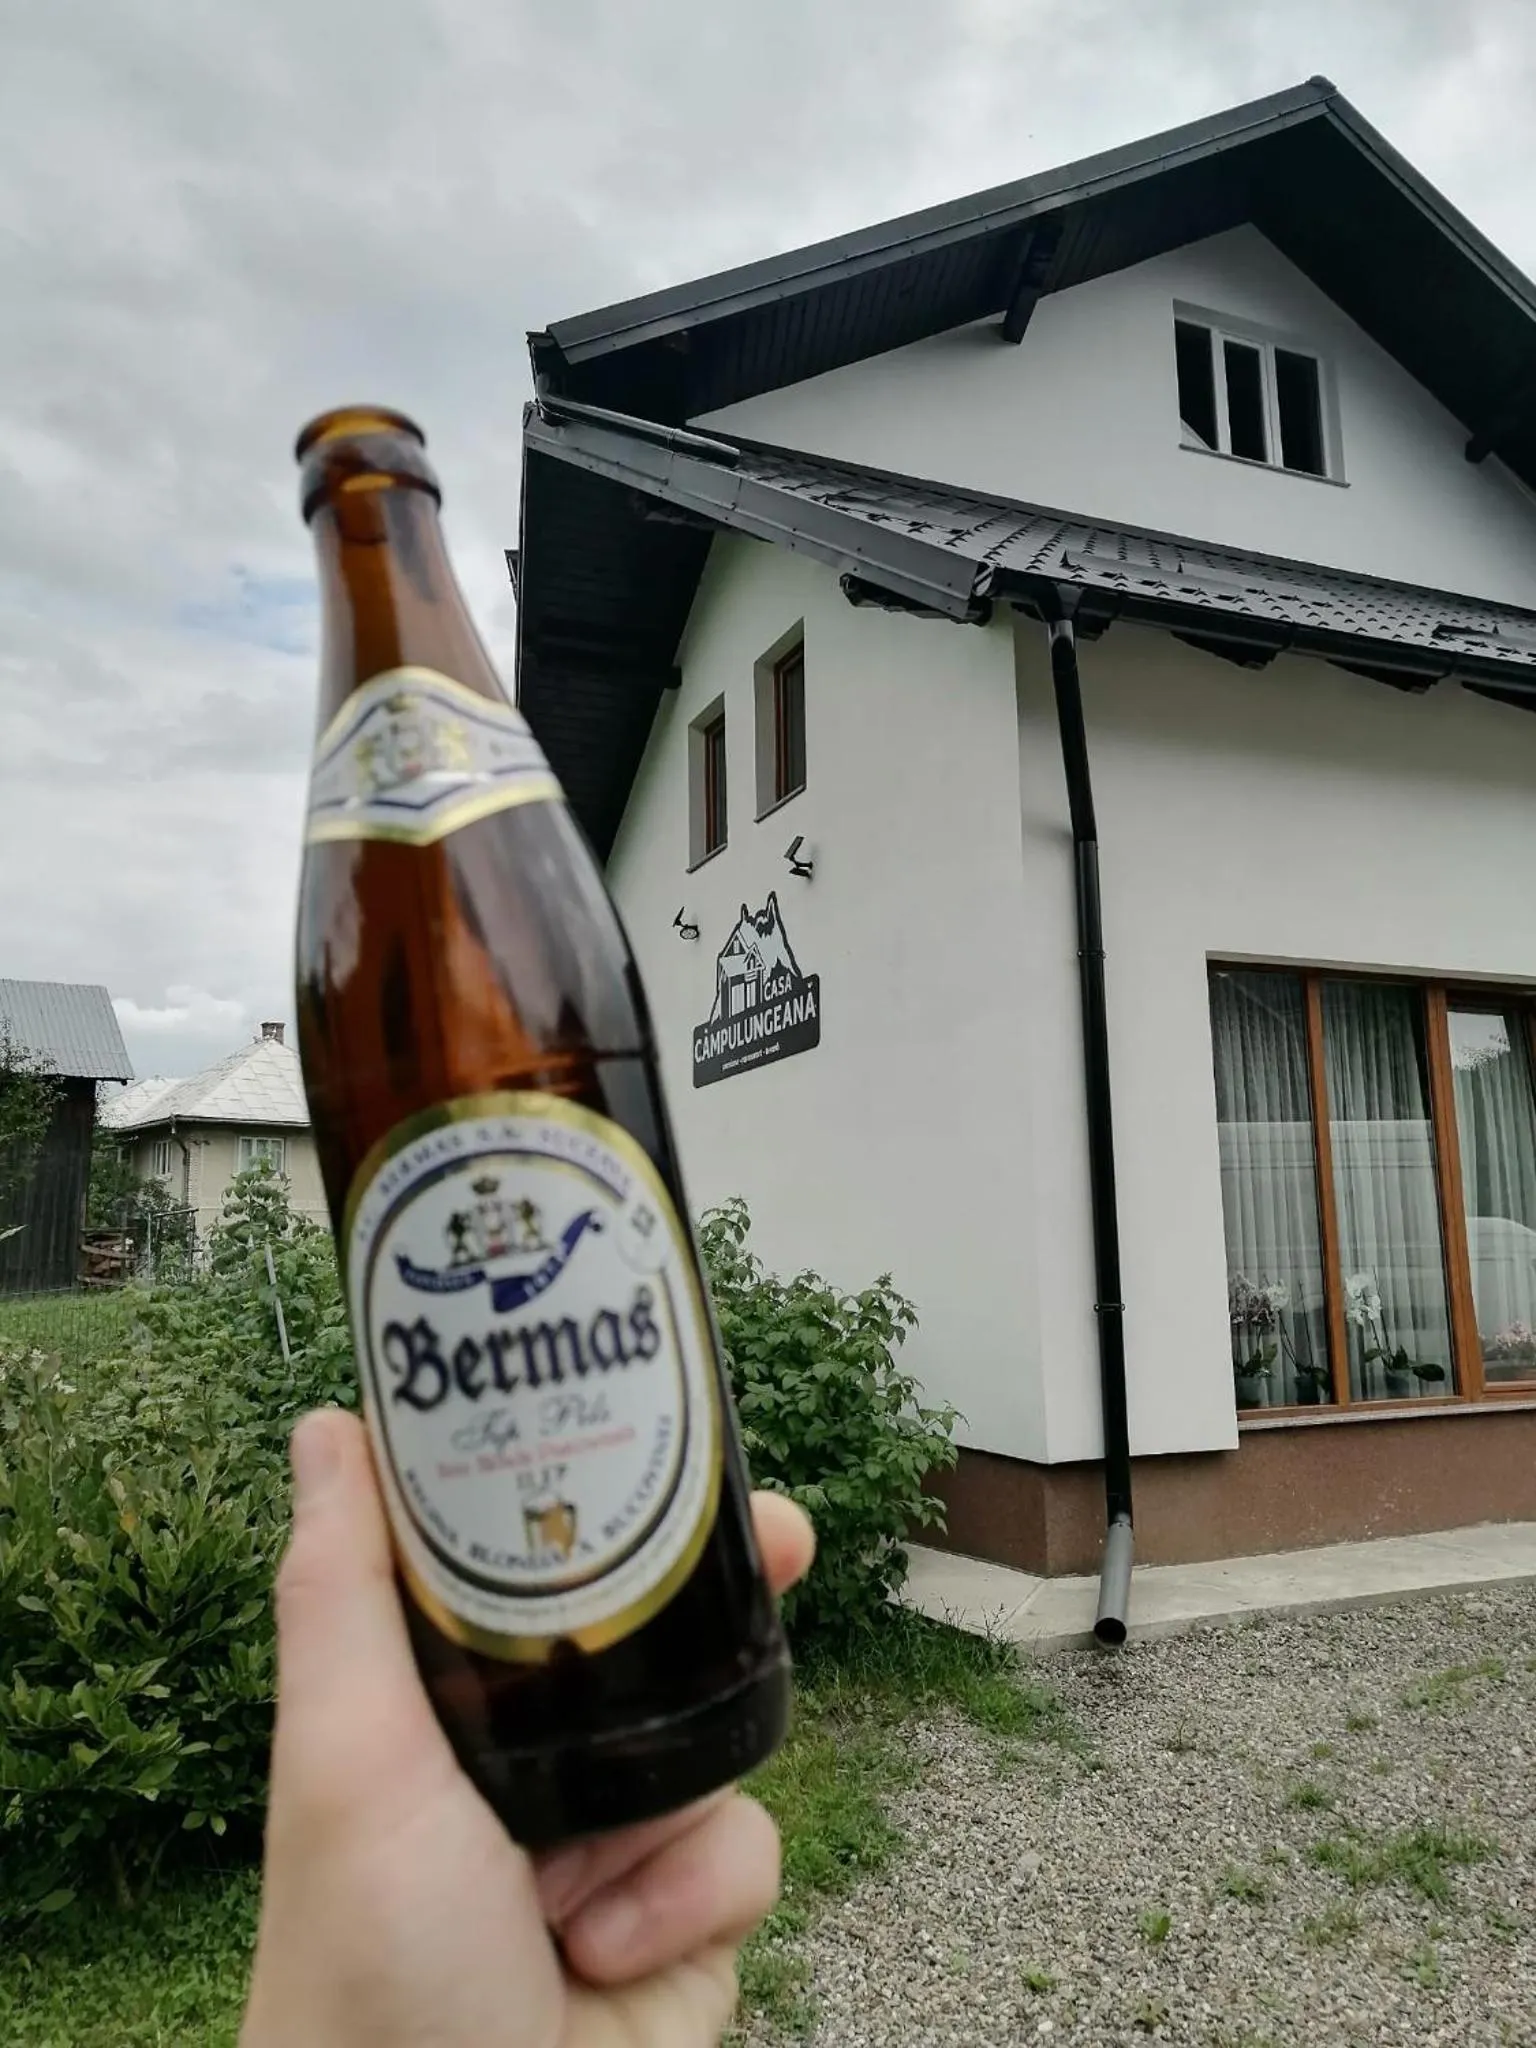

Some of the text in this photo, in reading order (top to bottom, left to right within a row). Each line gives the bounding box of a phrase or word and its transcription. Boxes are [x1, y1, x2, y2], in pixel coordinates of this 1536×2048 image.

[694, 980, 817, 1065] CÂMPULUNGEANĂ
[763, 972, 793, 1002] CASA
[382, 1284, 661, 1414] Bermas
